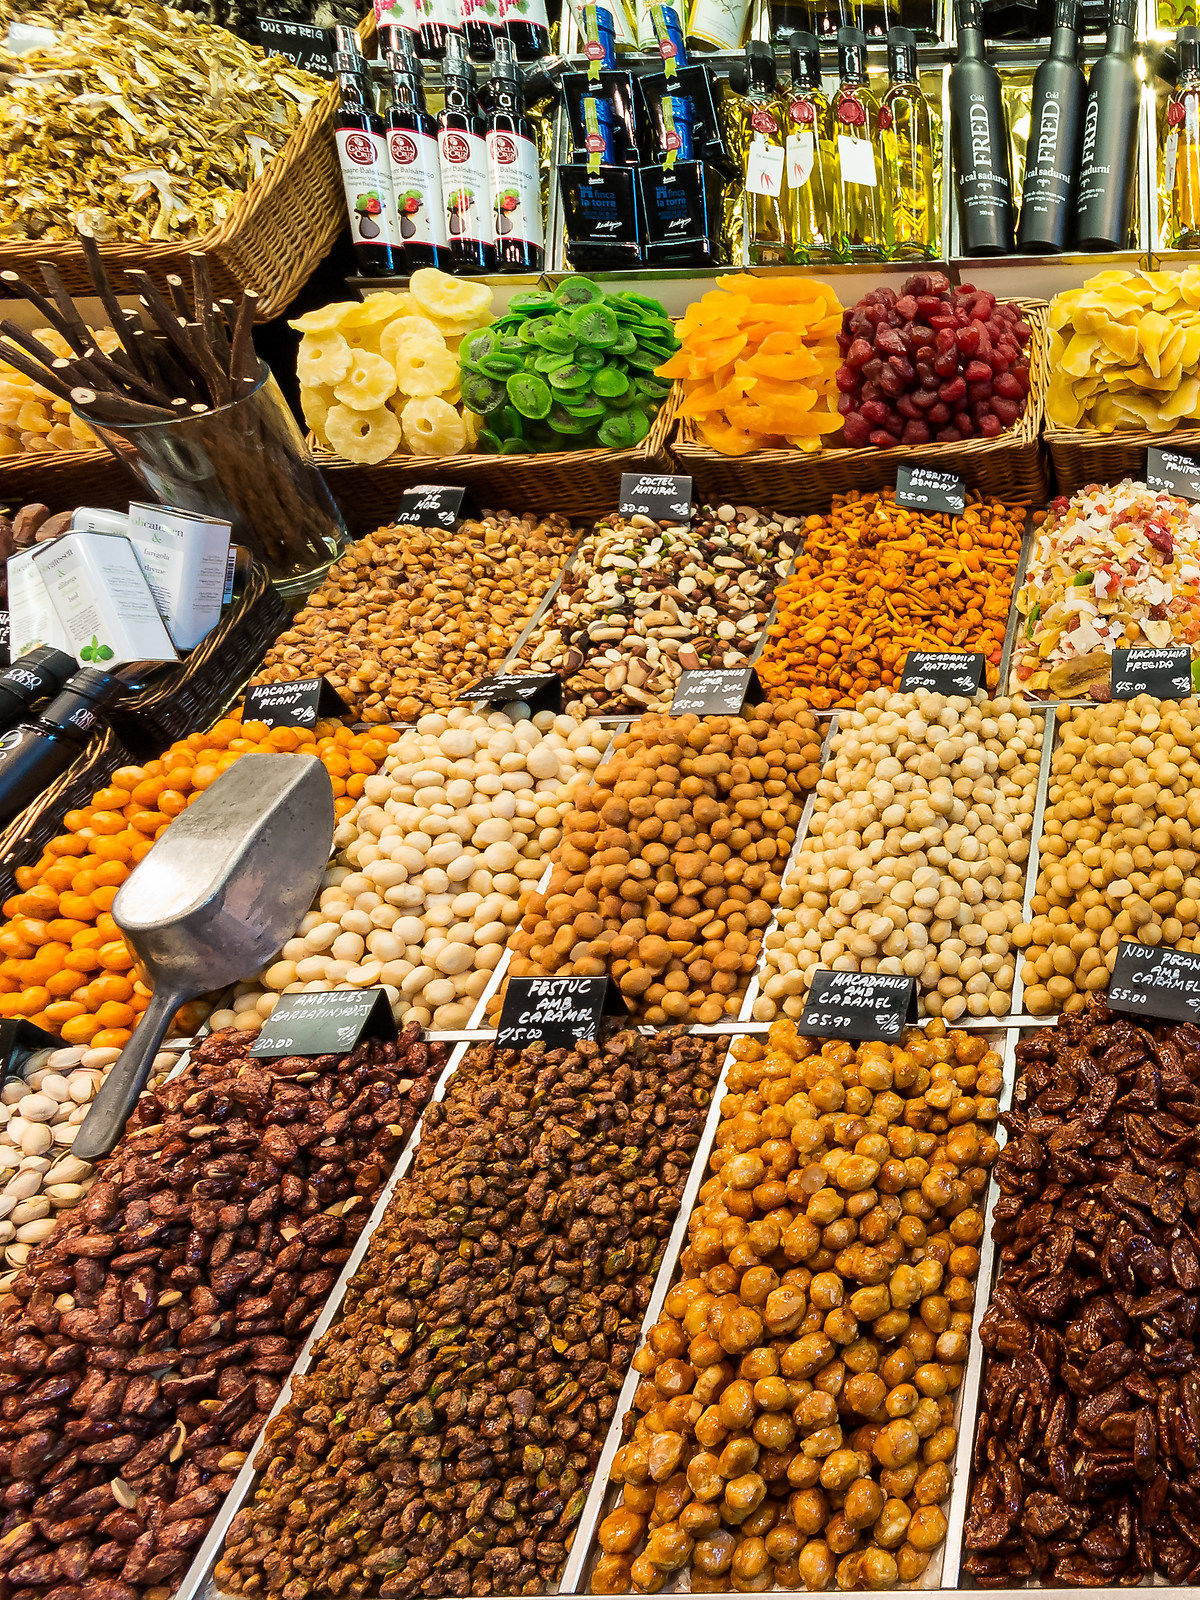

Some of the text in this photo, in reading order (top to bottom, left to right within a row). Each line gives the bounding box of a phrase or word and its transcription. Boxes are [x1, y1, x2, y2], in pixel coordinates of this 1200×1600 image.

[260, 21, 282, 34] OUS
[284, 25, 297, 35] DE
[970, 94, 985, 102] Cold
[1045, 91, 1060, 99] Cold
[970, 104, 993, 167] FRED
[1037, 100, 1060, 164] FRED
[1082, 101, 1099, 166] FRED
[594, 189, 615, 199] finca
[668, 188, 686, 197] finca
[581, 199, 616, 207] la torre
[657, 197, 687, 207] la torre
[1161, 452, 1195, 466] COCTEL
[639, 477, 675, 486] COCTEL
[630, 484, 679, 495] NATURAL
[912, 652, 976, 662] MACADAMIA
[1126, 649, 1187, 662] MACADAMIA
[1125, 660, 1174, 673] FREGIDA
[250, 681, 319, 700] MACADAMIA
[1115, 680, 1147, 693] 45.00
[1150, 965, 1181, 980] AMB
[527, 979, 592, 998] FESTUC
[829, 973, 910, 990] MACADAMIA
[843, 985, 875, 998] AMB
[1109, 987, 1147, 1004] 55.00
[535, 996, 573, 1011] AMB
[818, 992, 892, 1009] CARAMEL
[518, 1007, 593, 1025] CARAMEL
[806, 1012, 852, 1028] 65.90
[498, 1026, 543, 1046] 45.00
